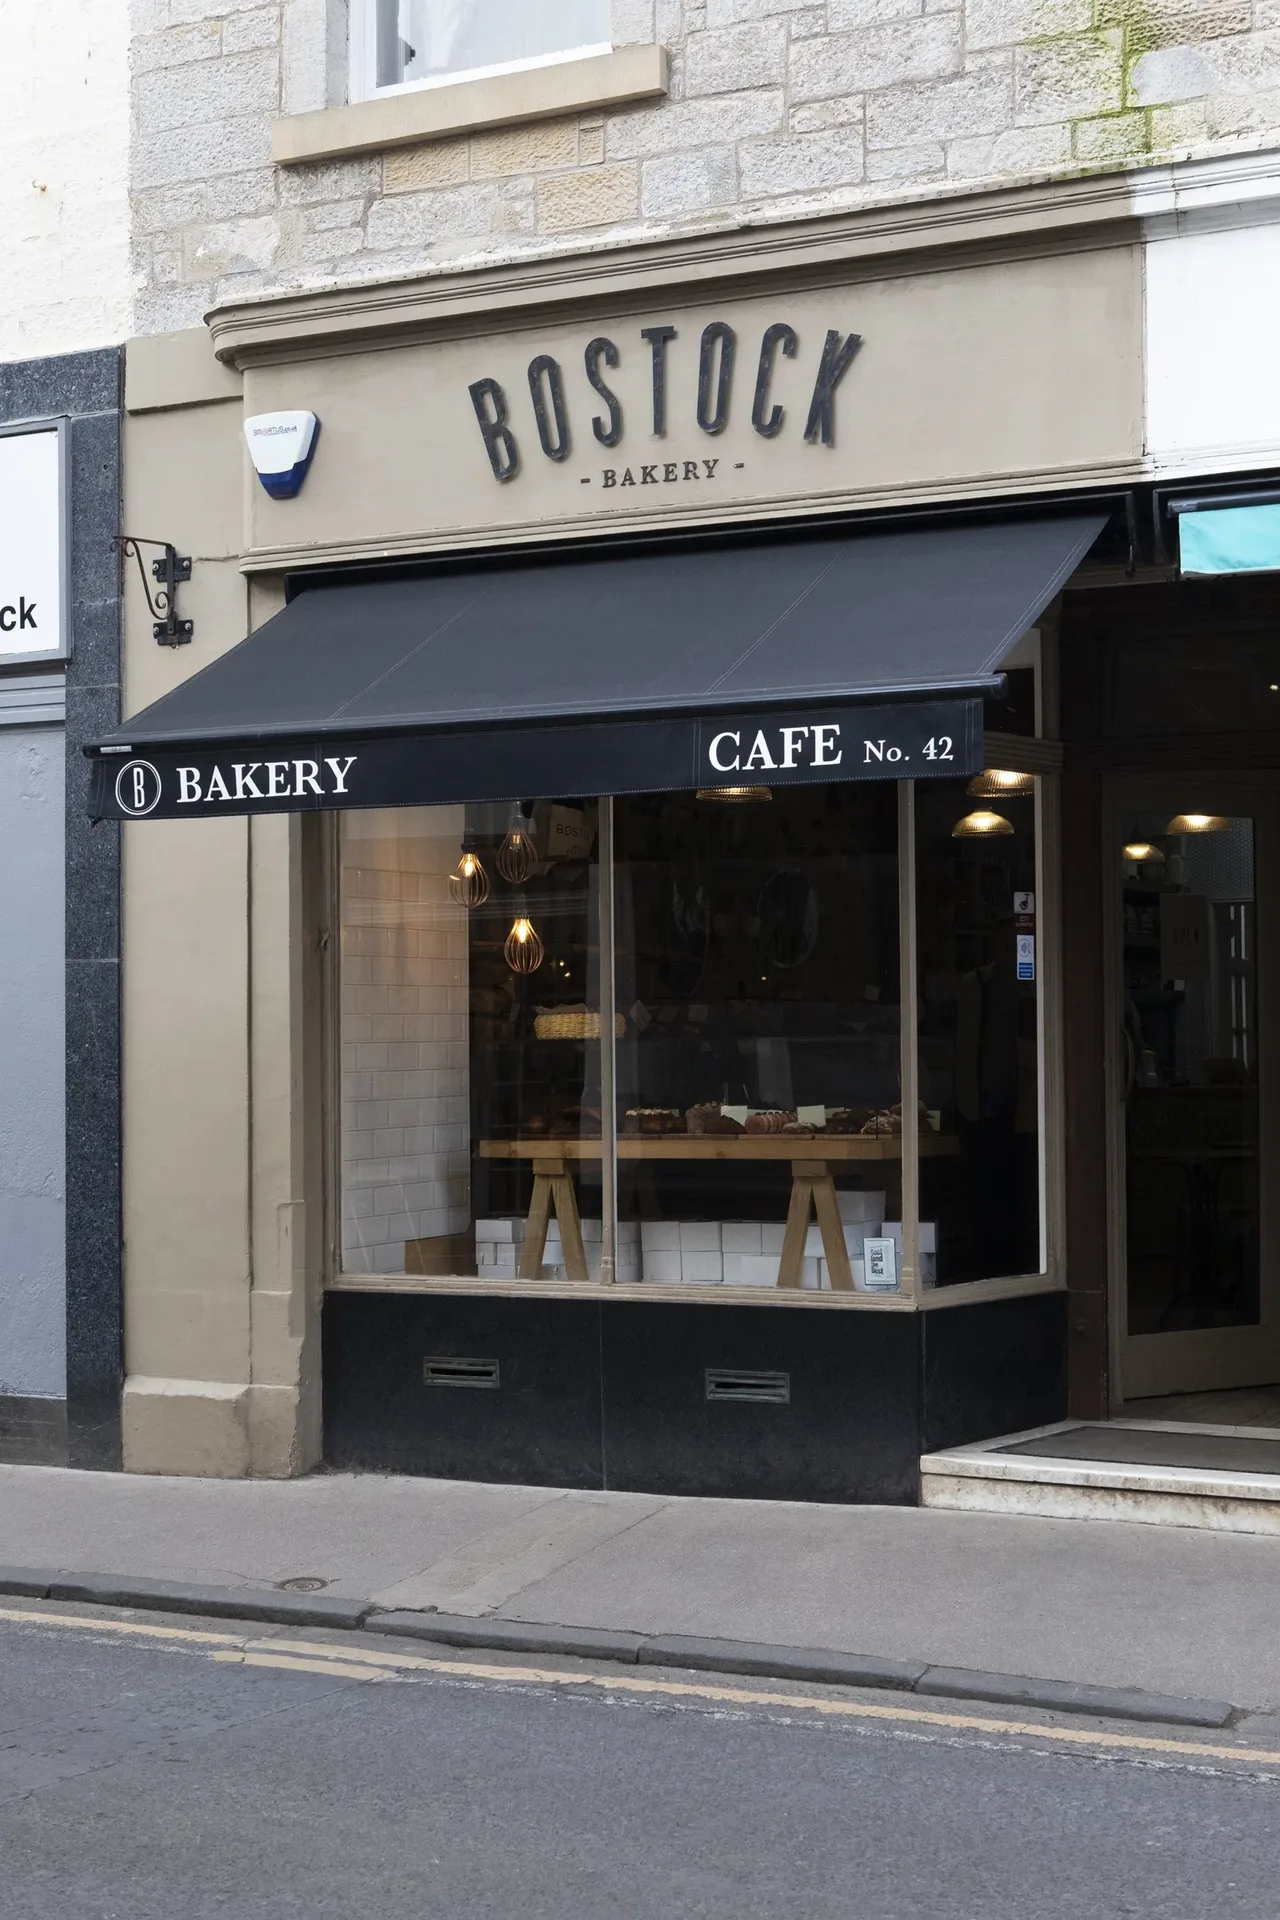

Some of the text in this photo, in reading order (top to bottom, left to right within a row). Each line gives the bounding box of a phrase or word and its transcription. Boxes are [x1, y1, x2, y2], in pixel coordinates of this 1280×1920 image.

[467, 321, 863, 484] BOSTOCK
[601, 458, 720, 489] BAKERY
[0, 595, 38, 632] ck
[708, 724, 954, 772] CAFE No. 42
[132, 756, 358, 809] B BAKERY
